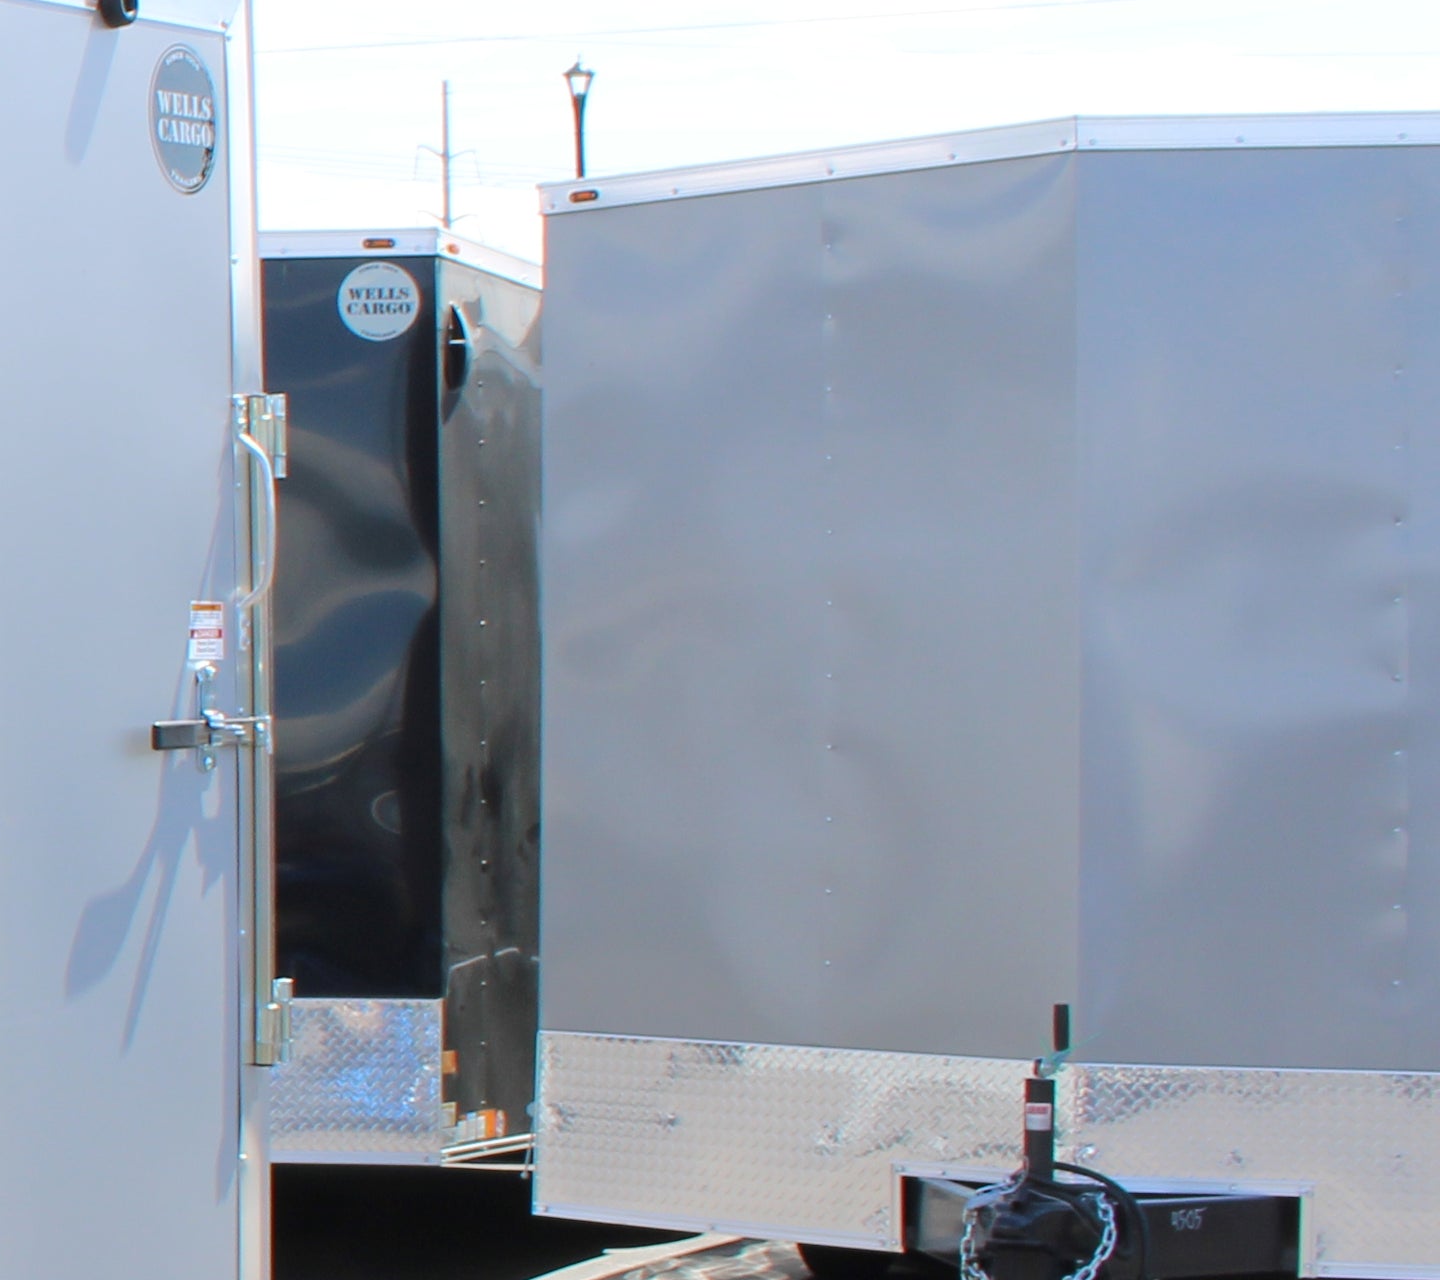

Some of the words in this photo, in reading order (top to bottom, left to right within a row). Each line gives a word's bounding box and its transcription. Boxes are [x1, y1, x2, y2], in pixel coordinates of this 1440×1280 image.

[157, 90, 212, 121] WELLS
[158, 118, 213, 147] CARGO
[348, 287, 410, 301] WELLS
[347, 302, 412, 315] CARGO
